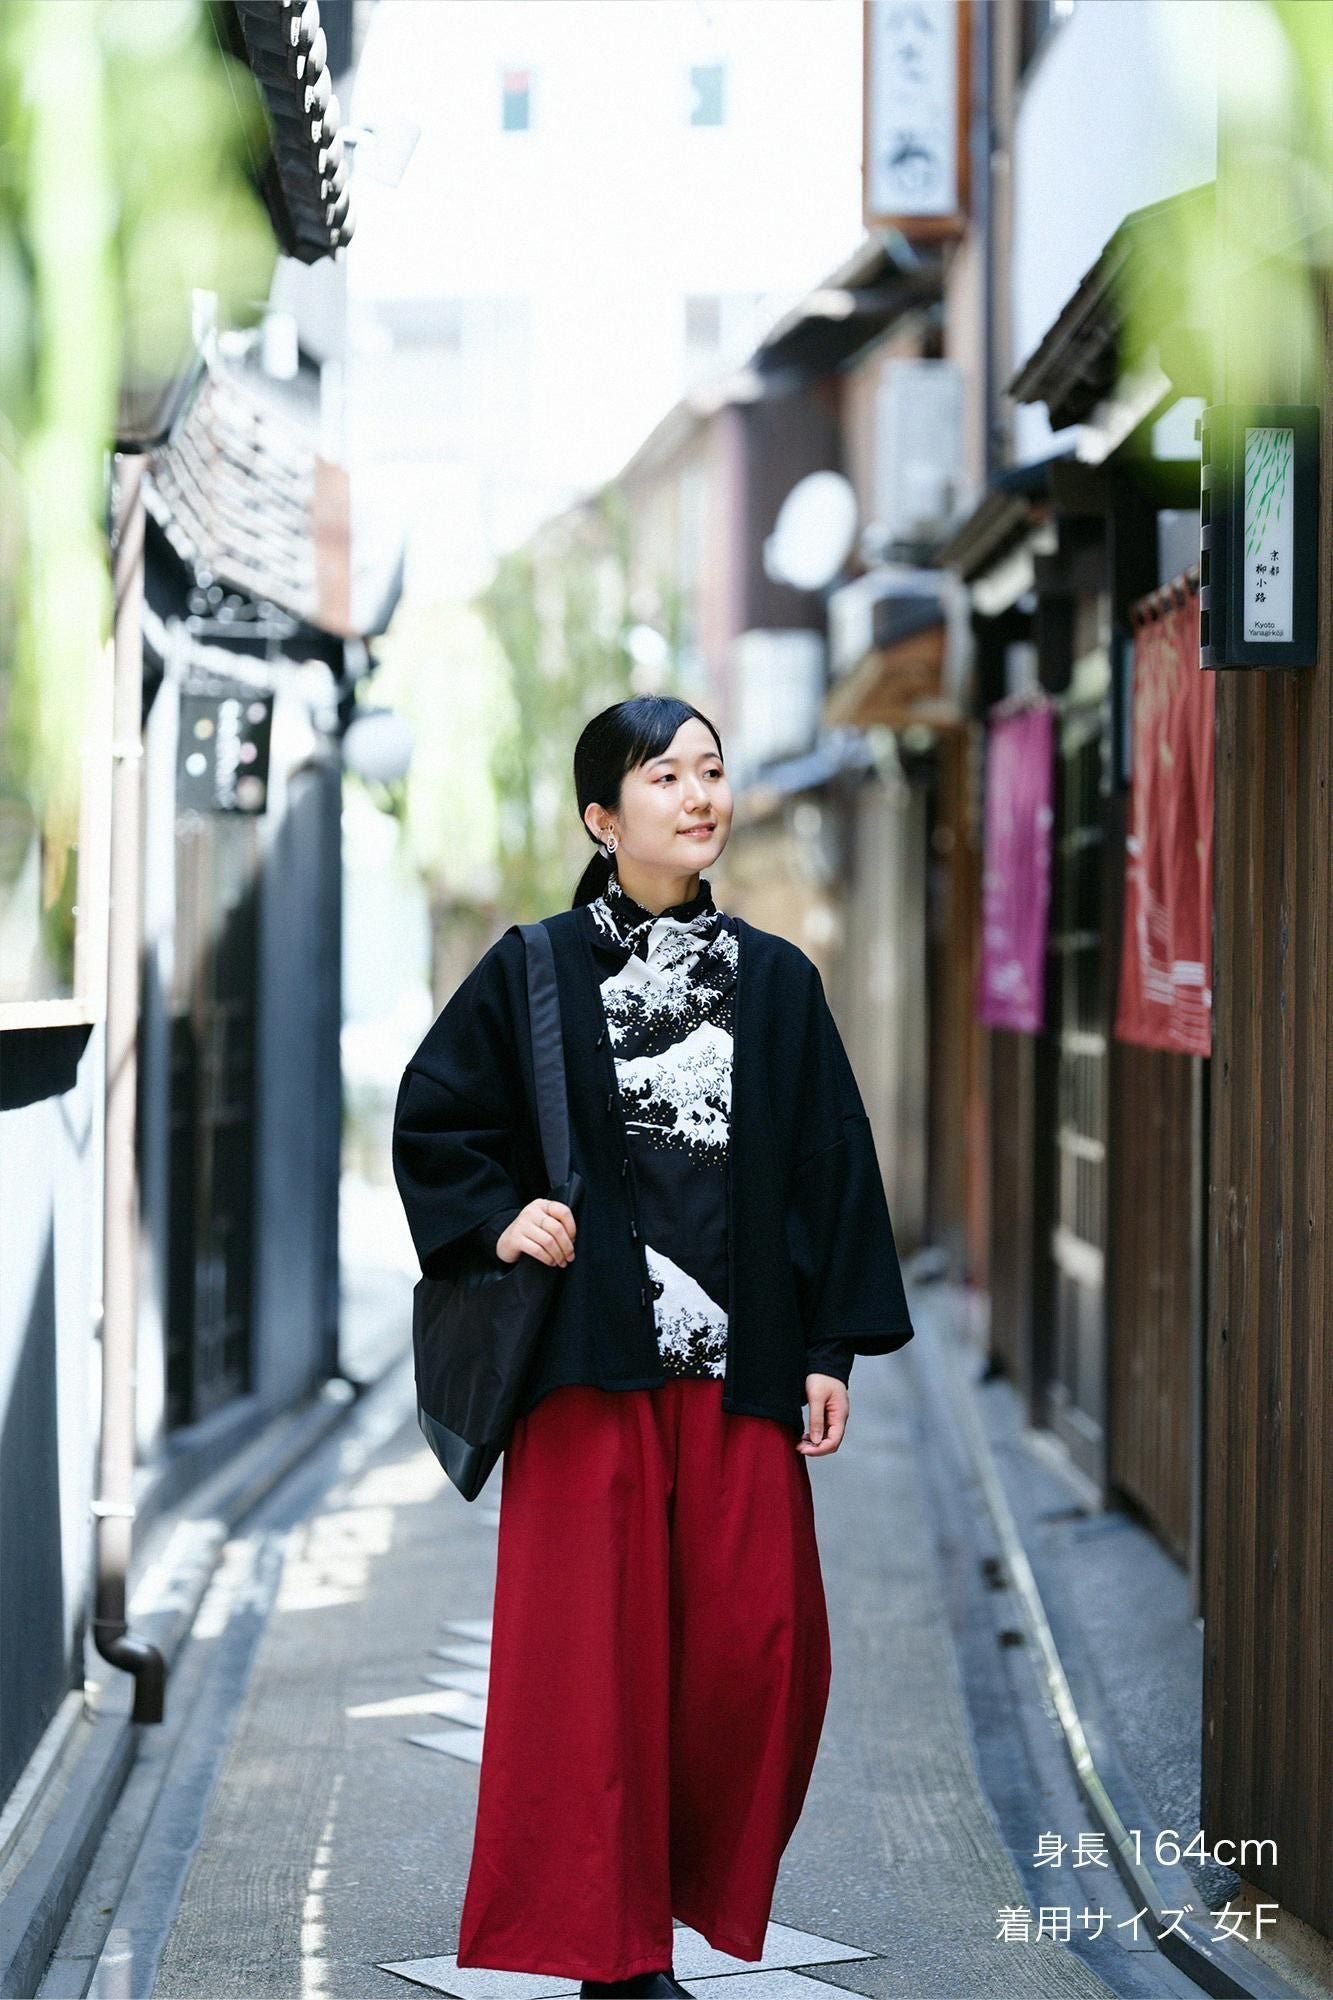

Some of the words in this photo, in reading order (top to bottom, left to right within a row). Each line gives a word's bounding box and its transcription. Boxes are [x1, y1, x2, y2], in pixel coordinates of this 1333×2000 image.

[1269, 550, 1280, 576] 京都
[1255, 563, 1267, 602] 柳小路
[1254, 620, 1275, 629] Kyoto
